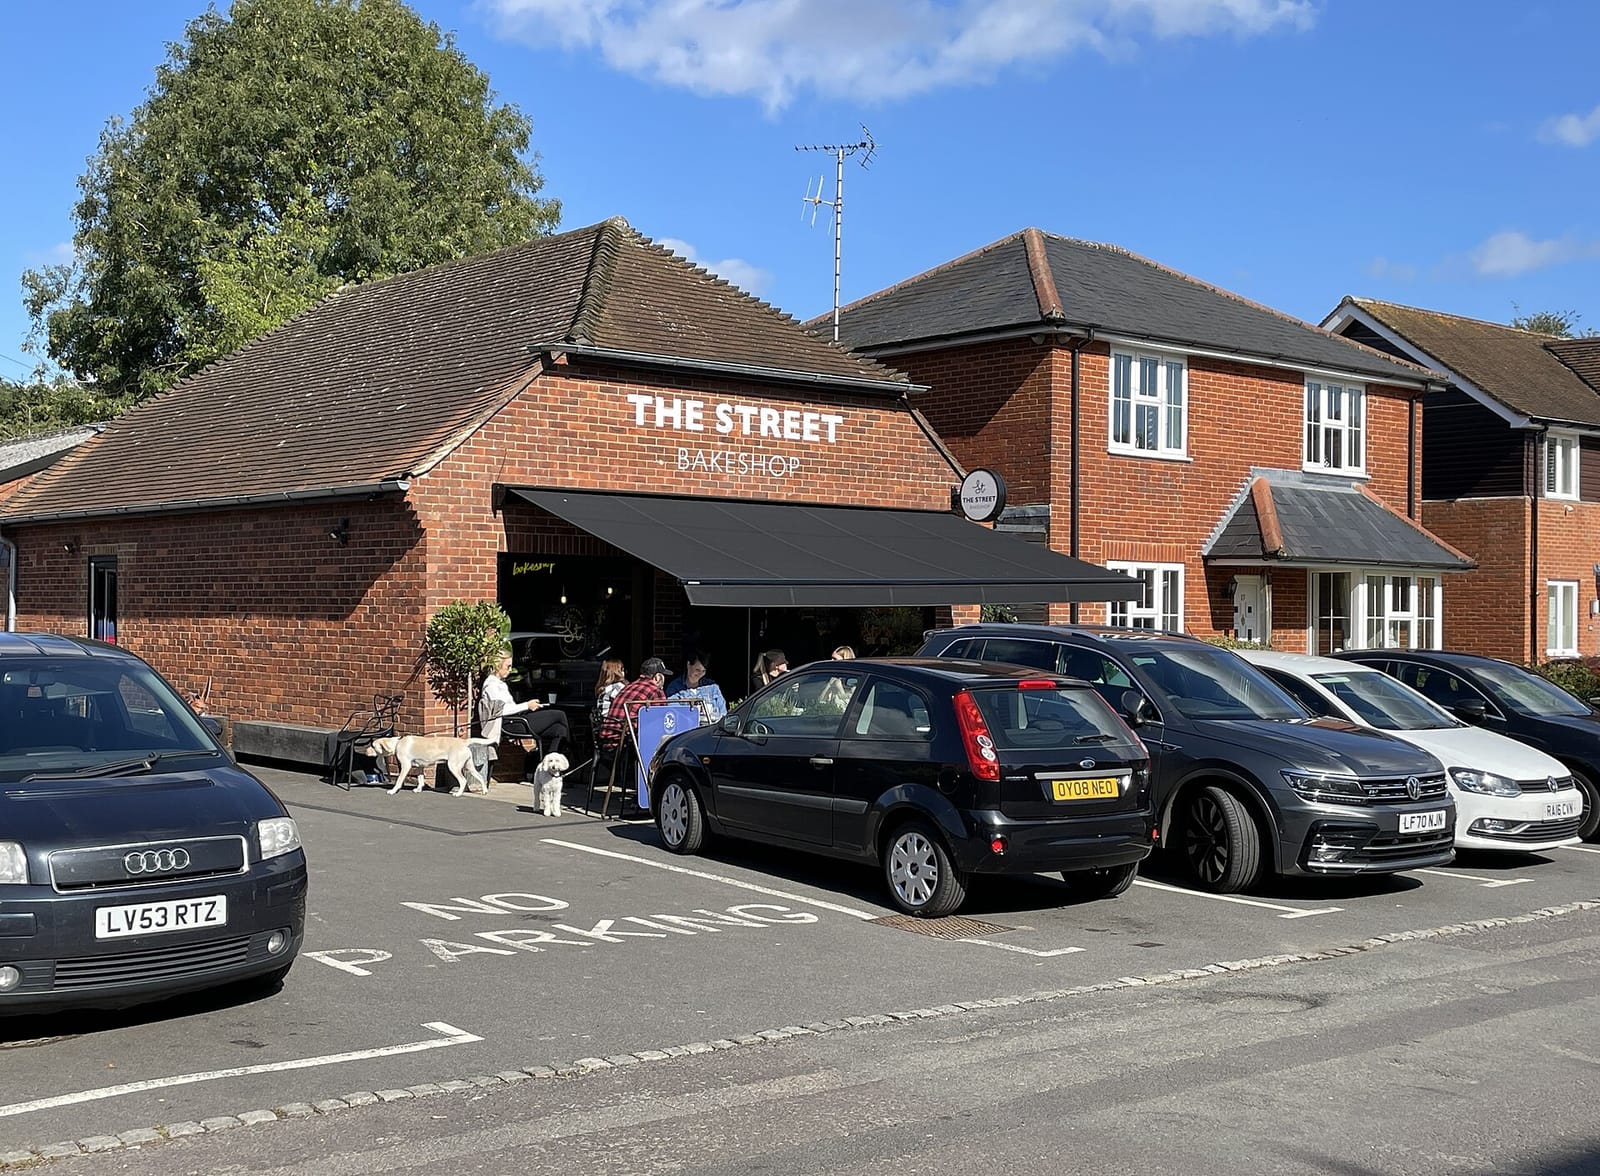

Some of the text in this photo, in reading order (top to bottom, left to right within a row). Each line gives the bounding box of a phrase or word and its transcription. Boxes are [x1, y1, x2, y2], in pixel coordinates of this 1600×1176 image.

[627, 393, 844, 443] THE STREET
[677, 447, 801, 477] BAKESHOP
[975, 495, 996, 503] STREET
[1058, 780, 1113, 797] OY08 NEO
[1403, 813, 1443, 829] LF70 NJN
[107, 900, 217, 933] LV53 RTZ
[400, 893, 570, 921] NO
